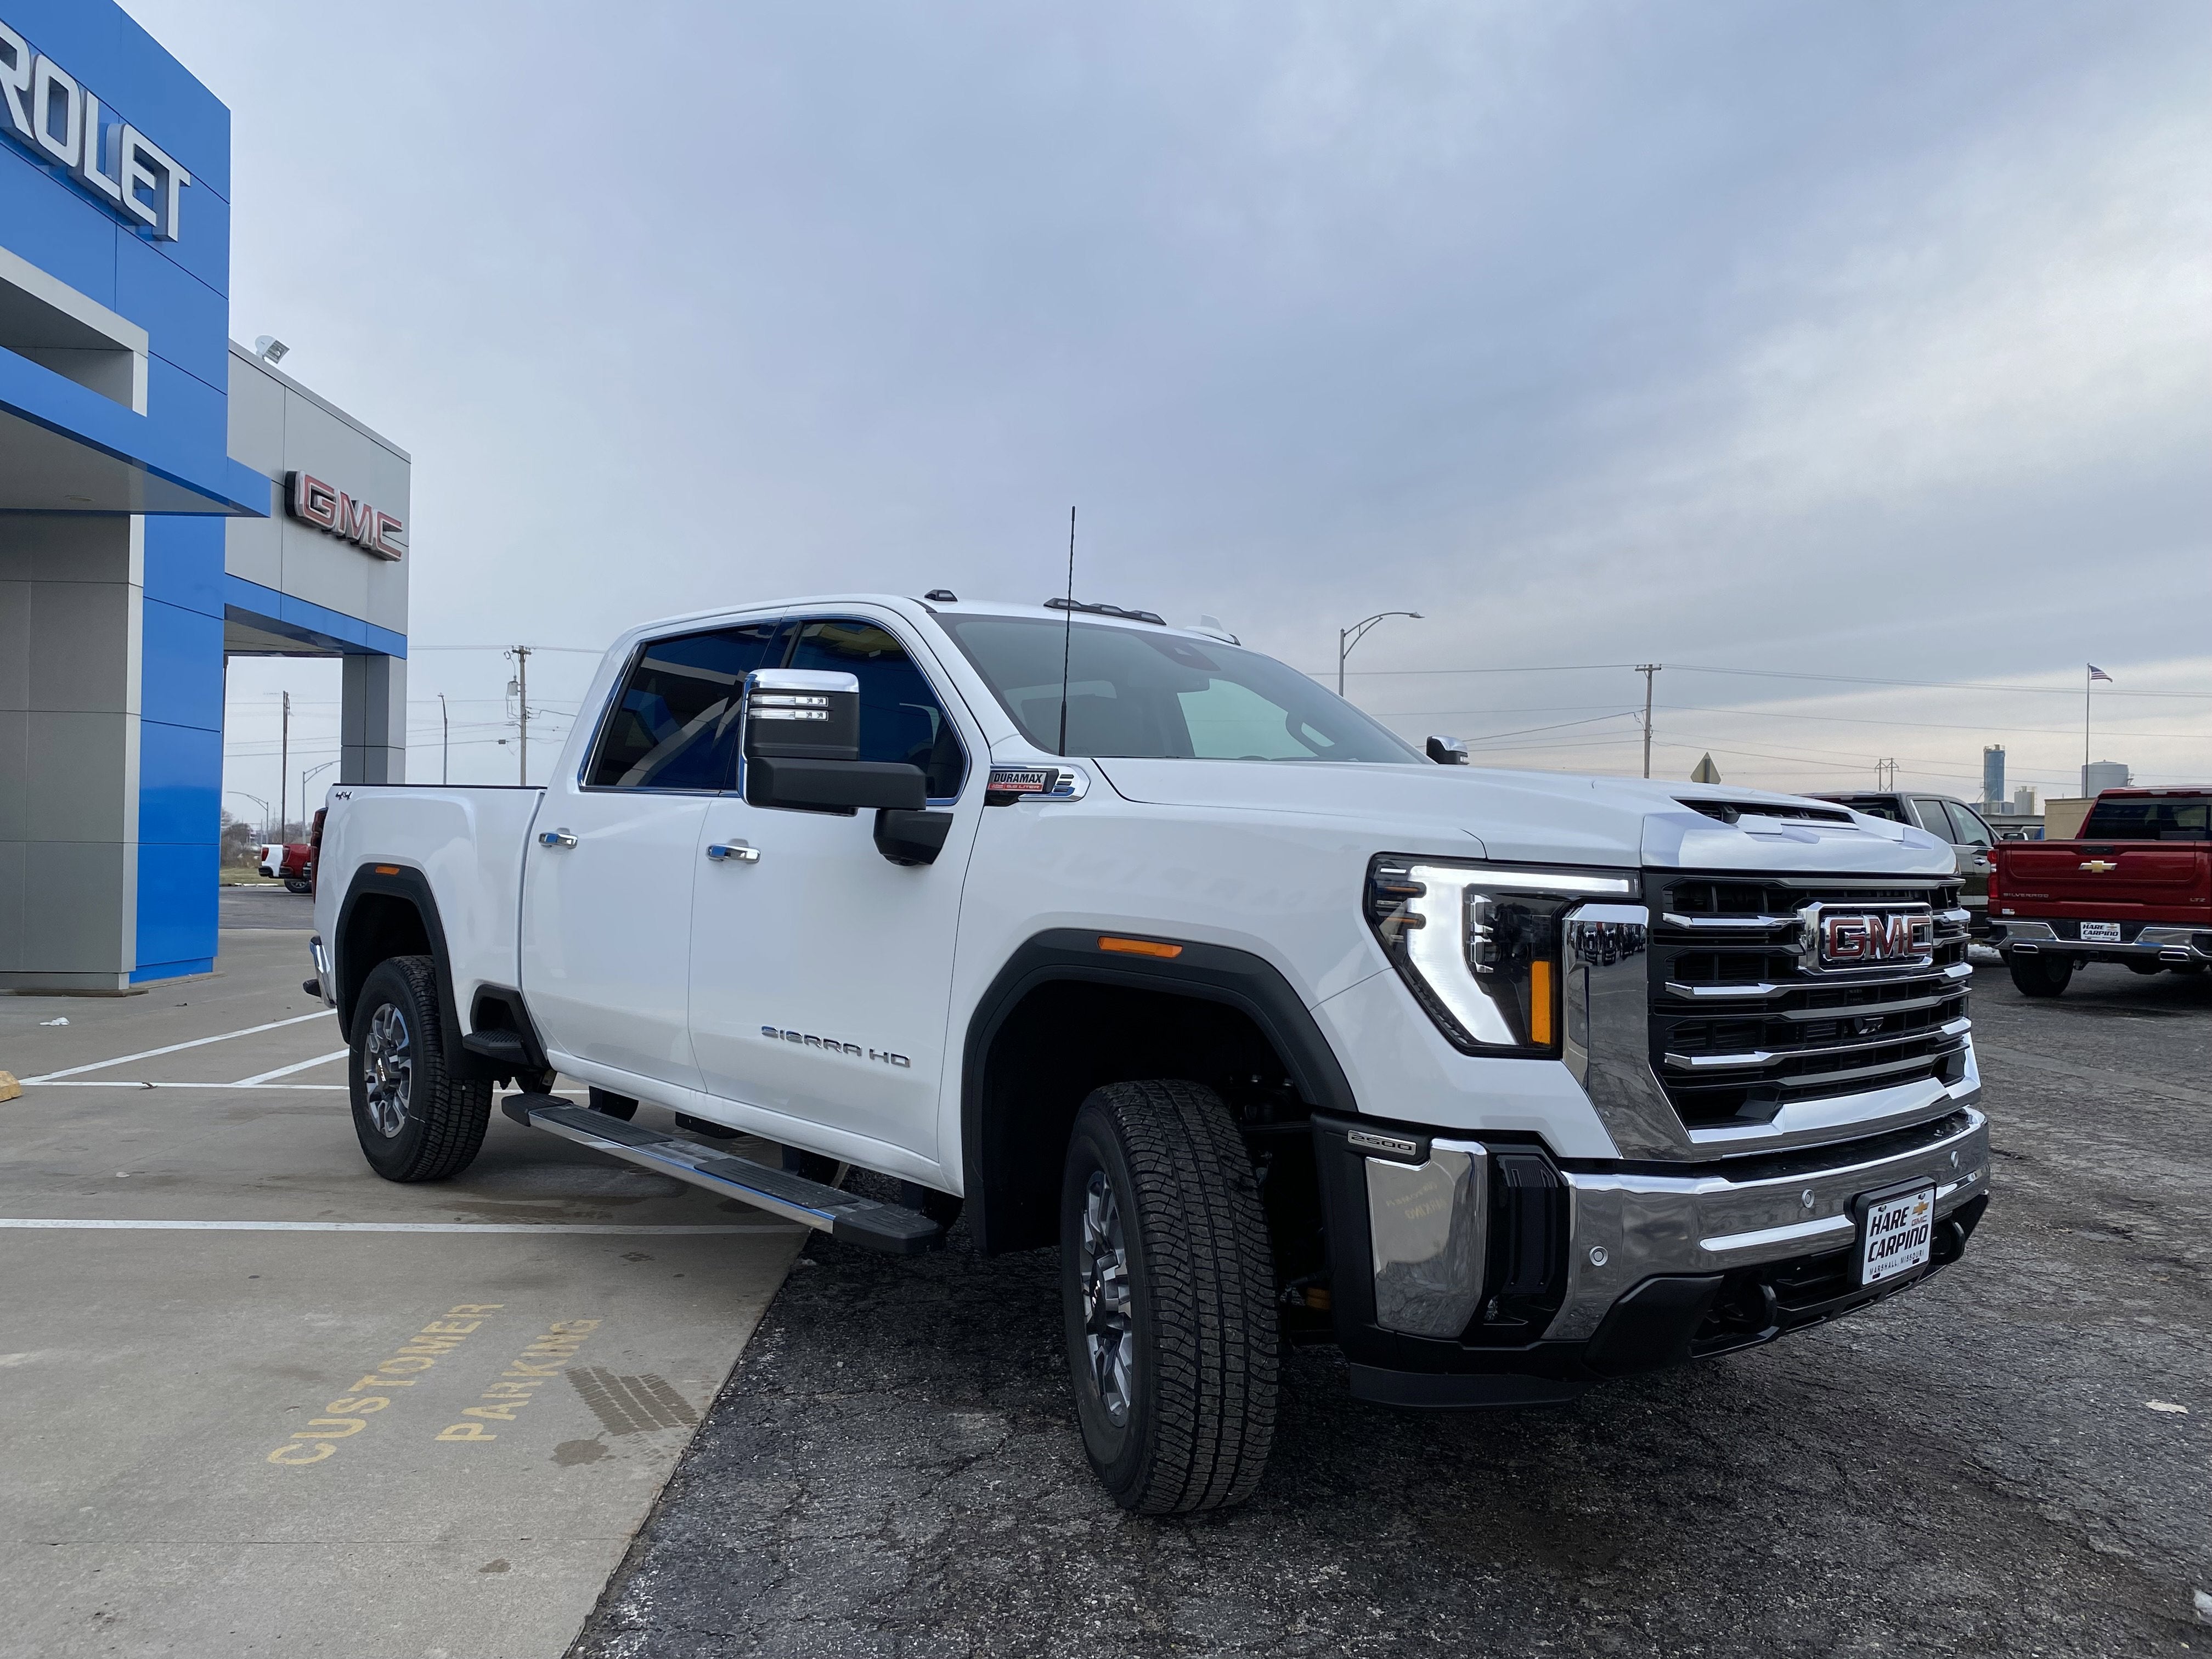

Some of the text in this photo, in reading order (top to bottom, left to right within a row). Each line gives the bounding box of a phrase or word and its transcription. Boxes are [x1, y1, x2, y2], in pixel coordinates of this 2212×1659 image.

[294, 470, 403, 562] GMC
[994, 773, 1043, 783] DURAMAX
[1821, 913, 1932, 961] GMC
[761, 1025, 911, 1068] SIERRA HD
[1351, 1134, 1412, 1151] 2500
[1869, 1206, 1910, 1238] HARE
[1911, 1215, 1928, 1227] GMC
[1867, 1223, 1929, 1263] CARPINO
[1900, 1249, 1925, 1263] MISSOURI
[266, 1303, 505, 1465] CUSTOMER
[433, 1318, 603, 1442] PARKING
